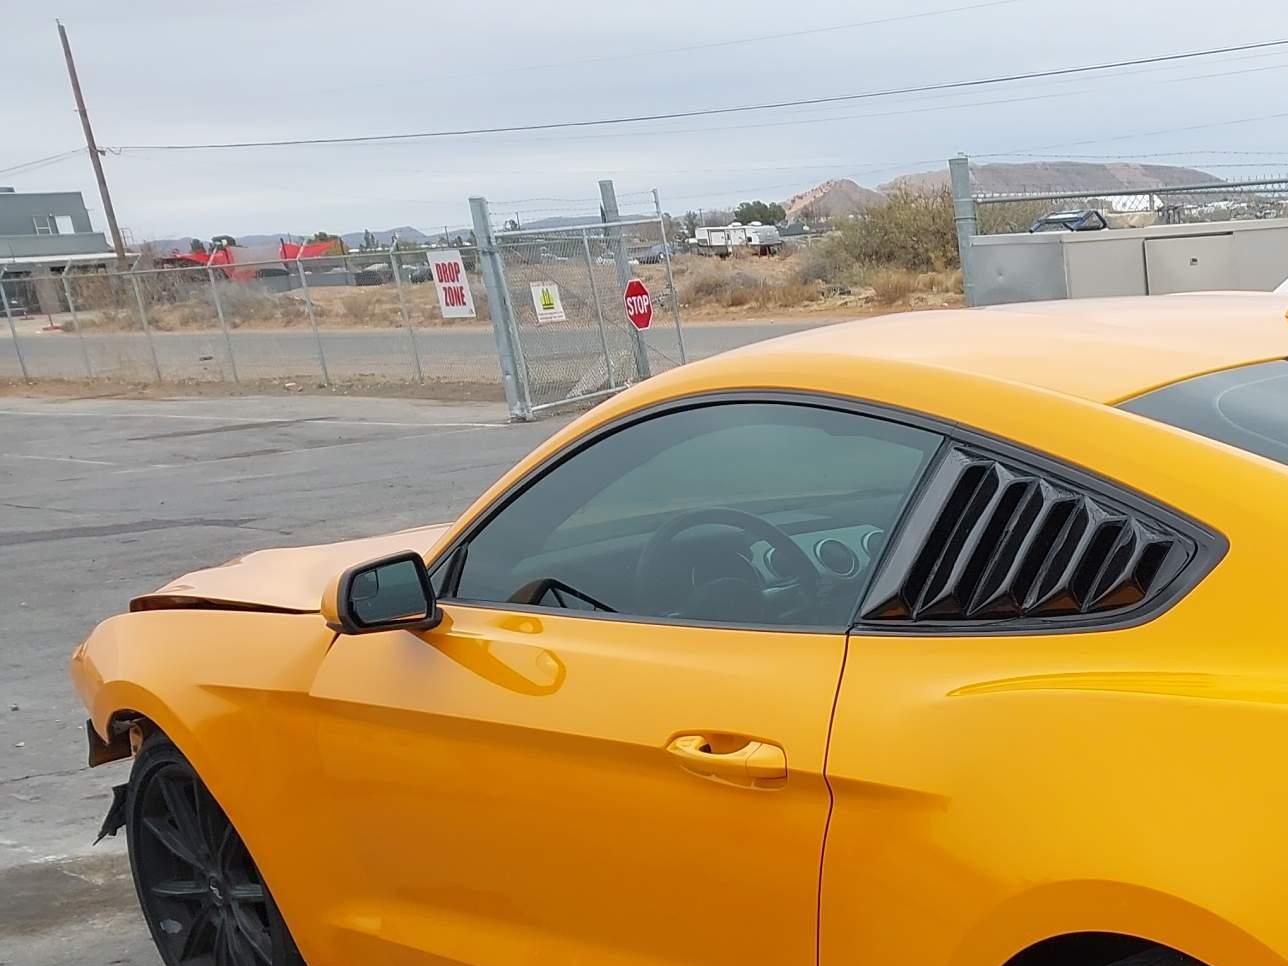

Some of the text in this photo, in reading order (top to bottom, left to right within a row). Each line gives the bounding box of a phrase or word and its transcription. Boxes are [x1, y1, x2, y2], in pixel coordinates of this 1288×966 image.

[435, 261, 460, 283] DROP
[442, 286, 467, 307] ZONE
[626, 294, 649, 316] STOP
